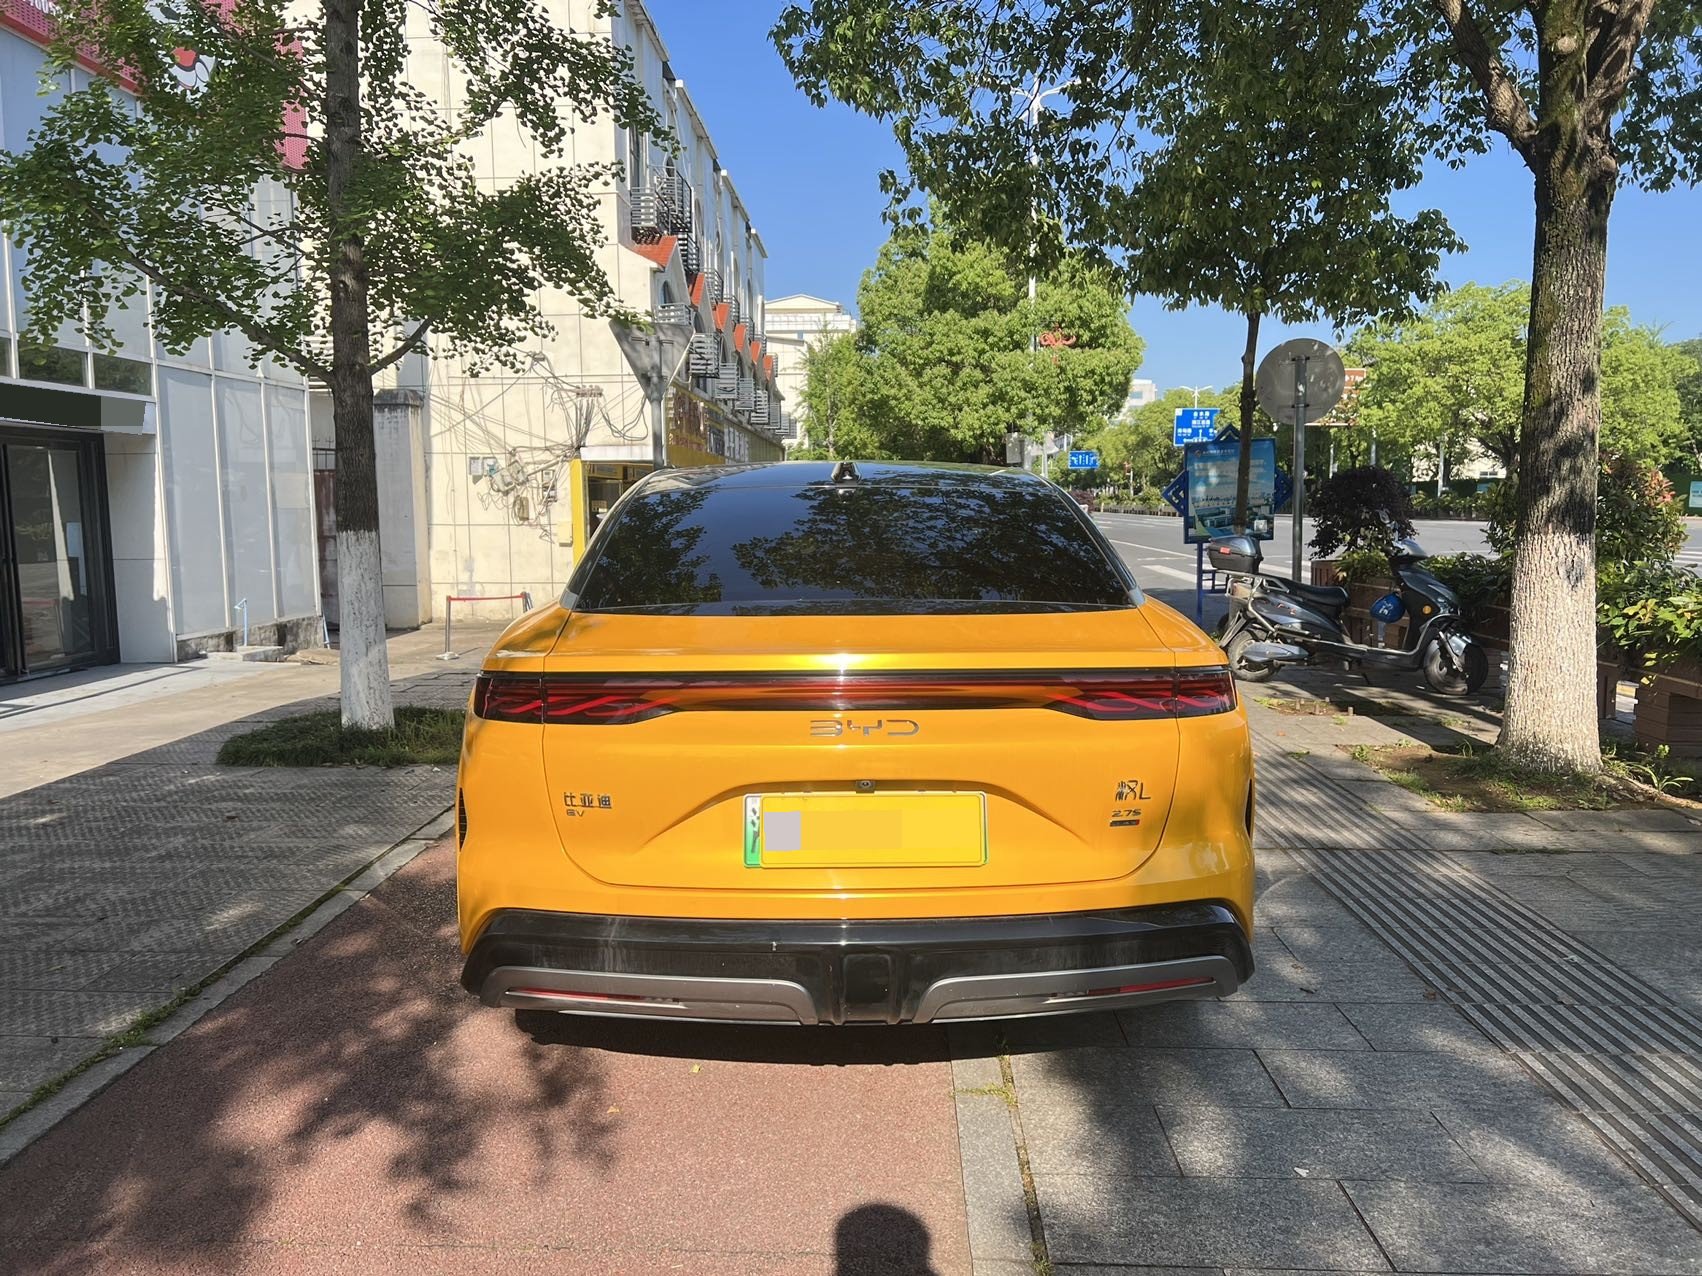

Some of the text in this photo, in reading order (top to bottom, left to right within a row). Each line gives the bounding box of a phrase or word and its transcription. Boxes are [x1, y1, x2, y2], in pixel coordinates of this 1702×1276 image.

[809, 719, 920, 737] BYD
[563, 791, 612, 809] 比亚迪
[566, 808, 585, 817] EV
